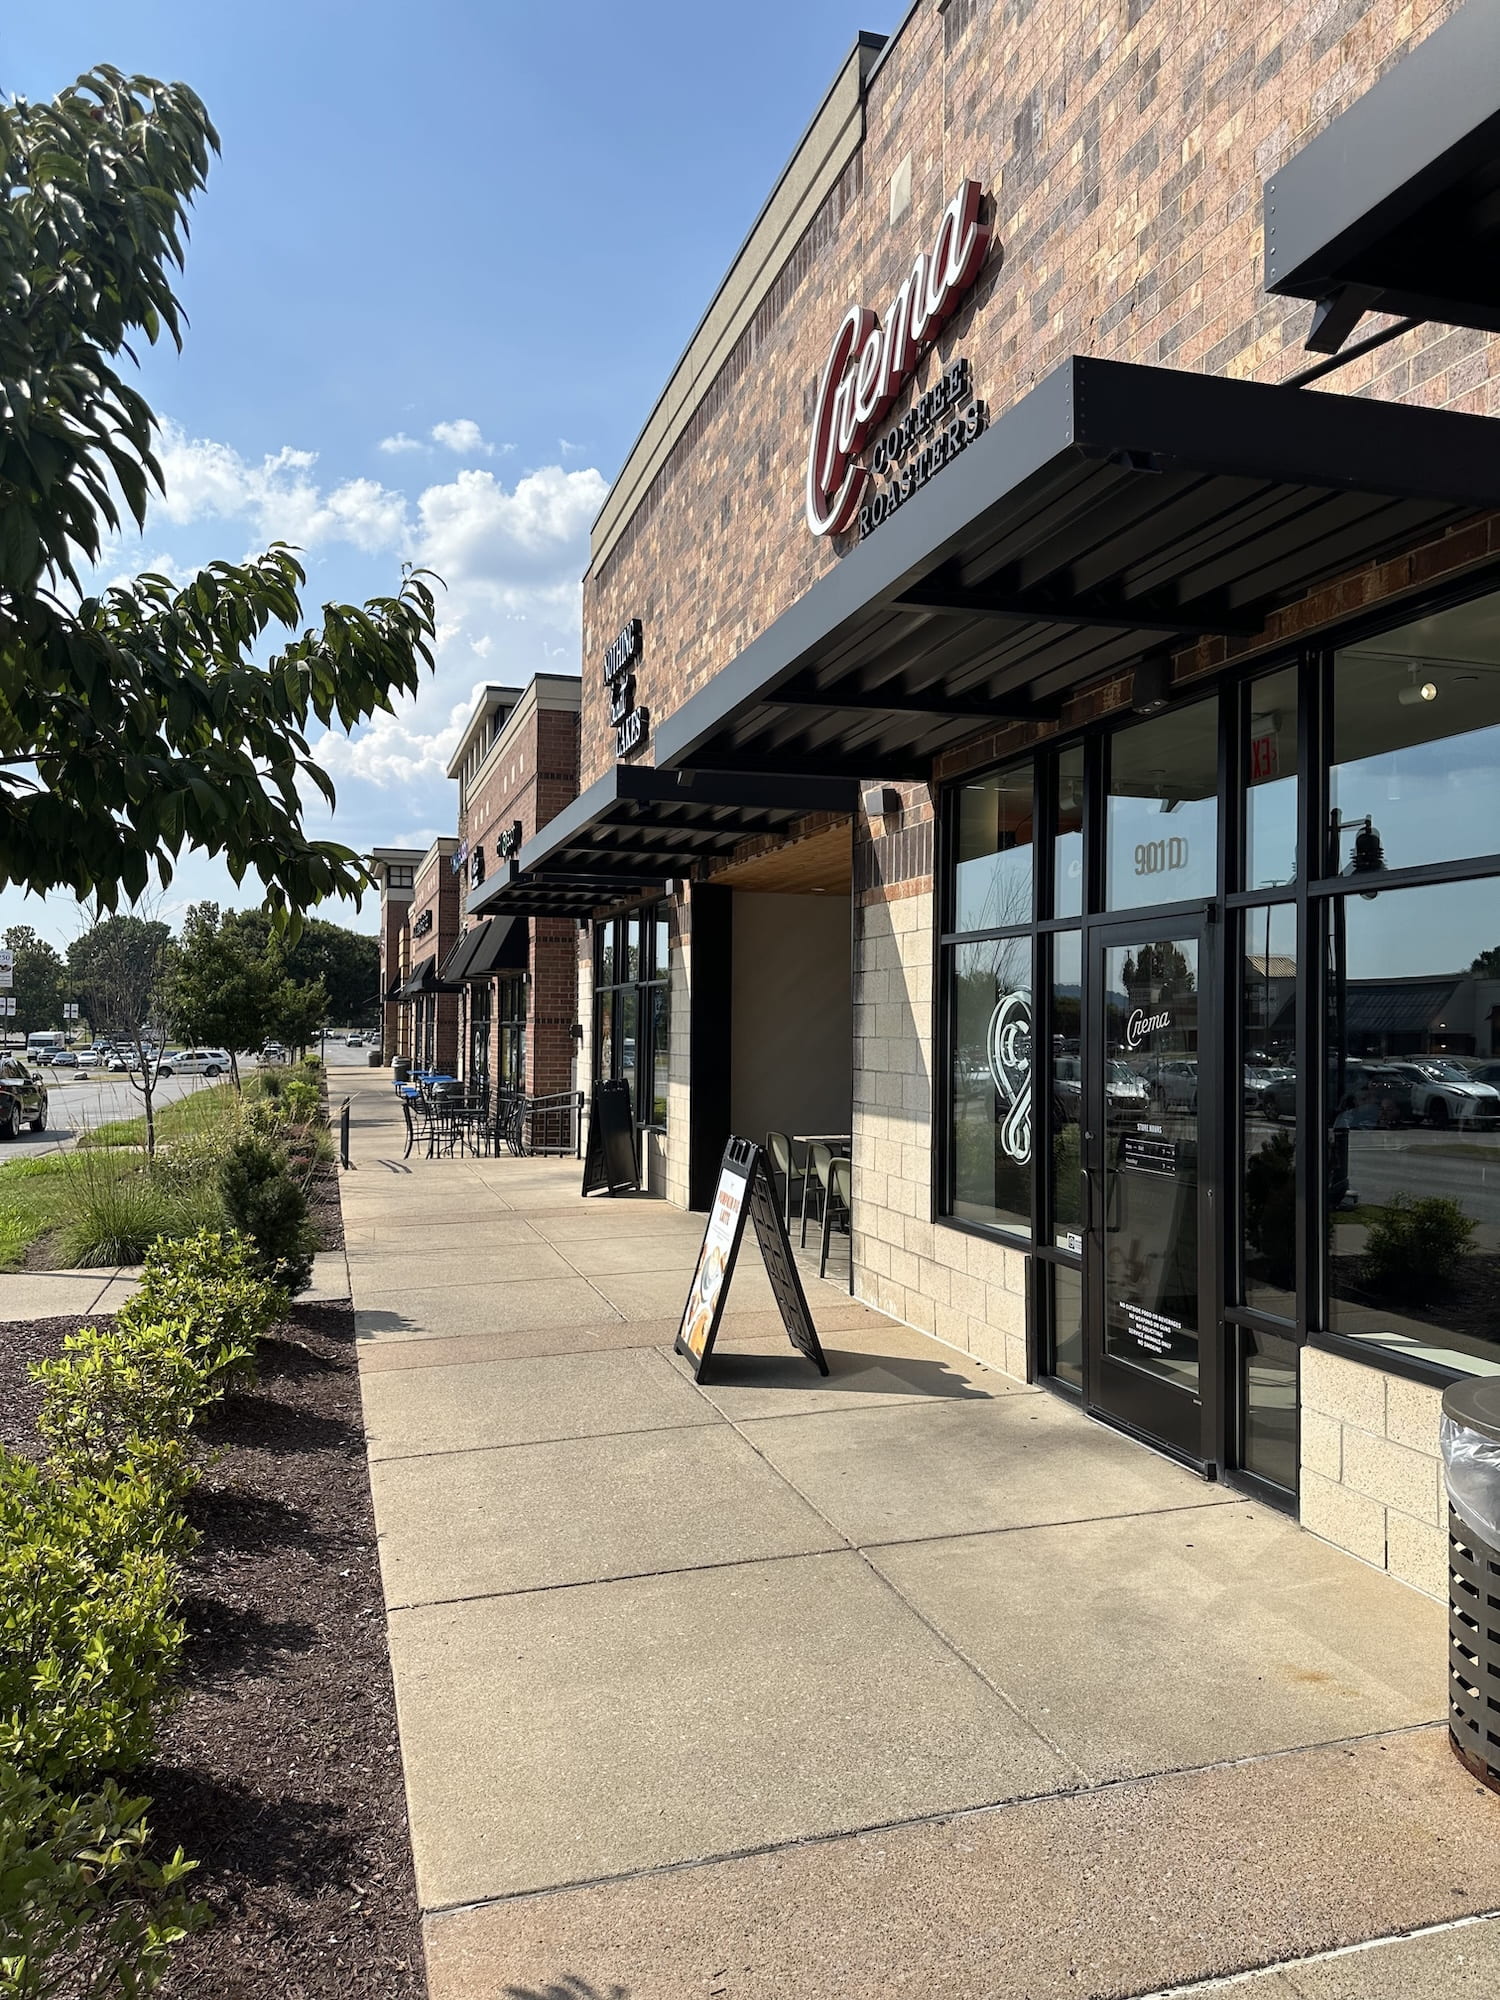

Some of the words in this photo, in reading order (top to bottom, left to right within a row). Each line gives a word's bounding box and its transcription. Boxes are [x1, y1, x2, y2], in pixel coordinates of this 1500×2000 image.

[806, 178, 985, 537] Crema
[871, 357, 972, 474] COFFEE
[858, 399, 988, 540] ROASTERS
[603, 619, 638, 685] NOTHING
[616, 707, 642, 758] CAKES
[1127, 1008, 1170, 1047] Crema
